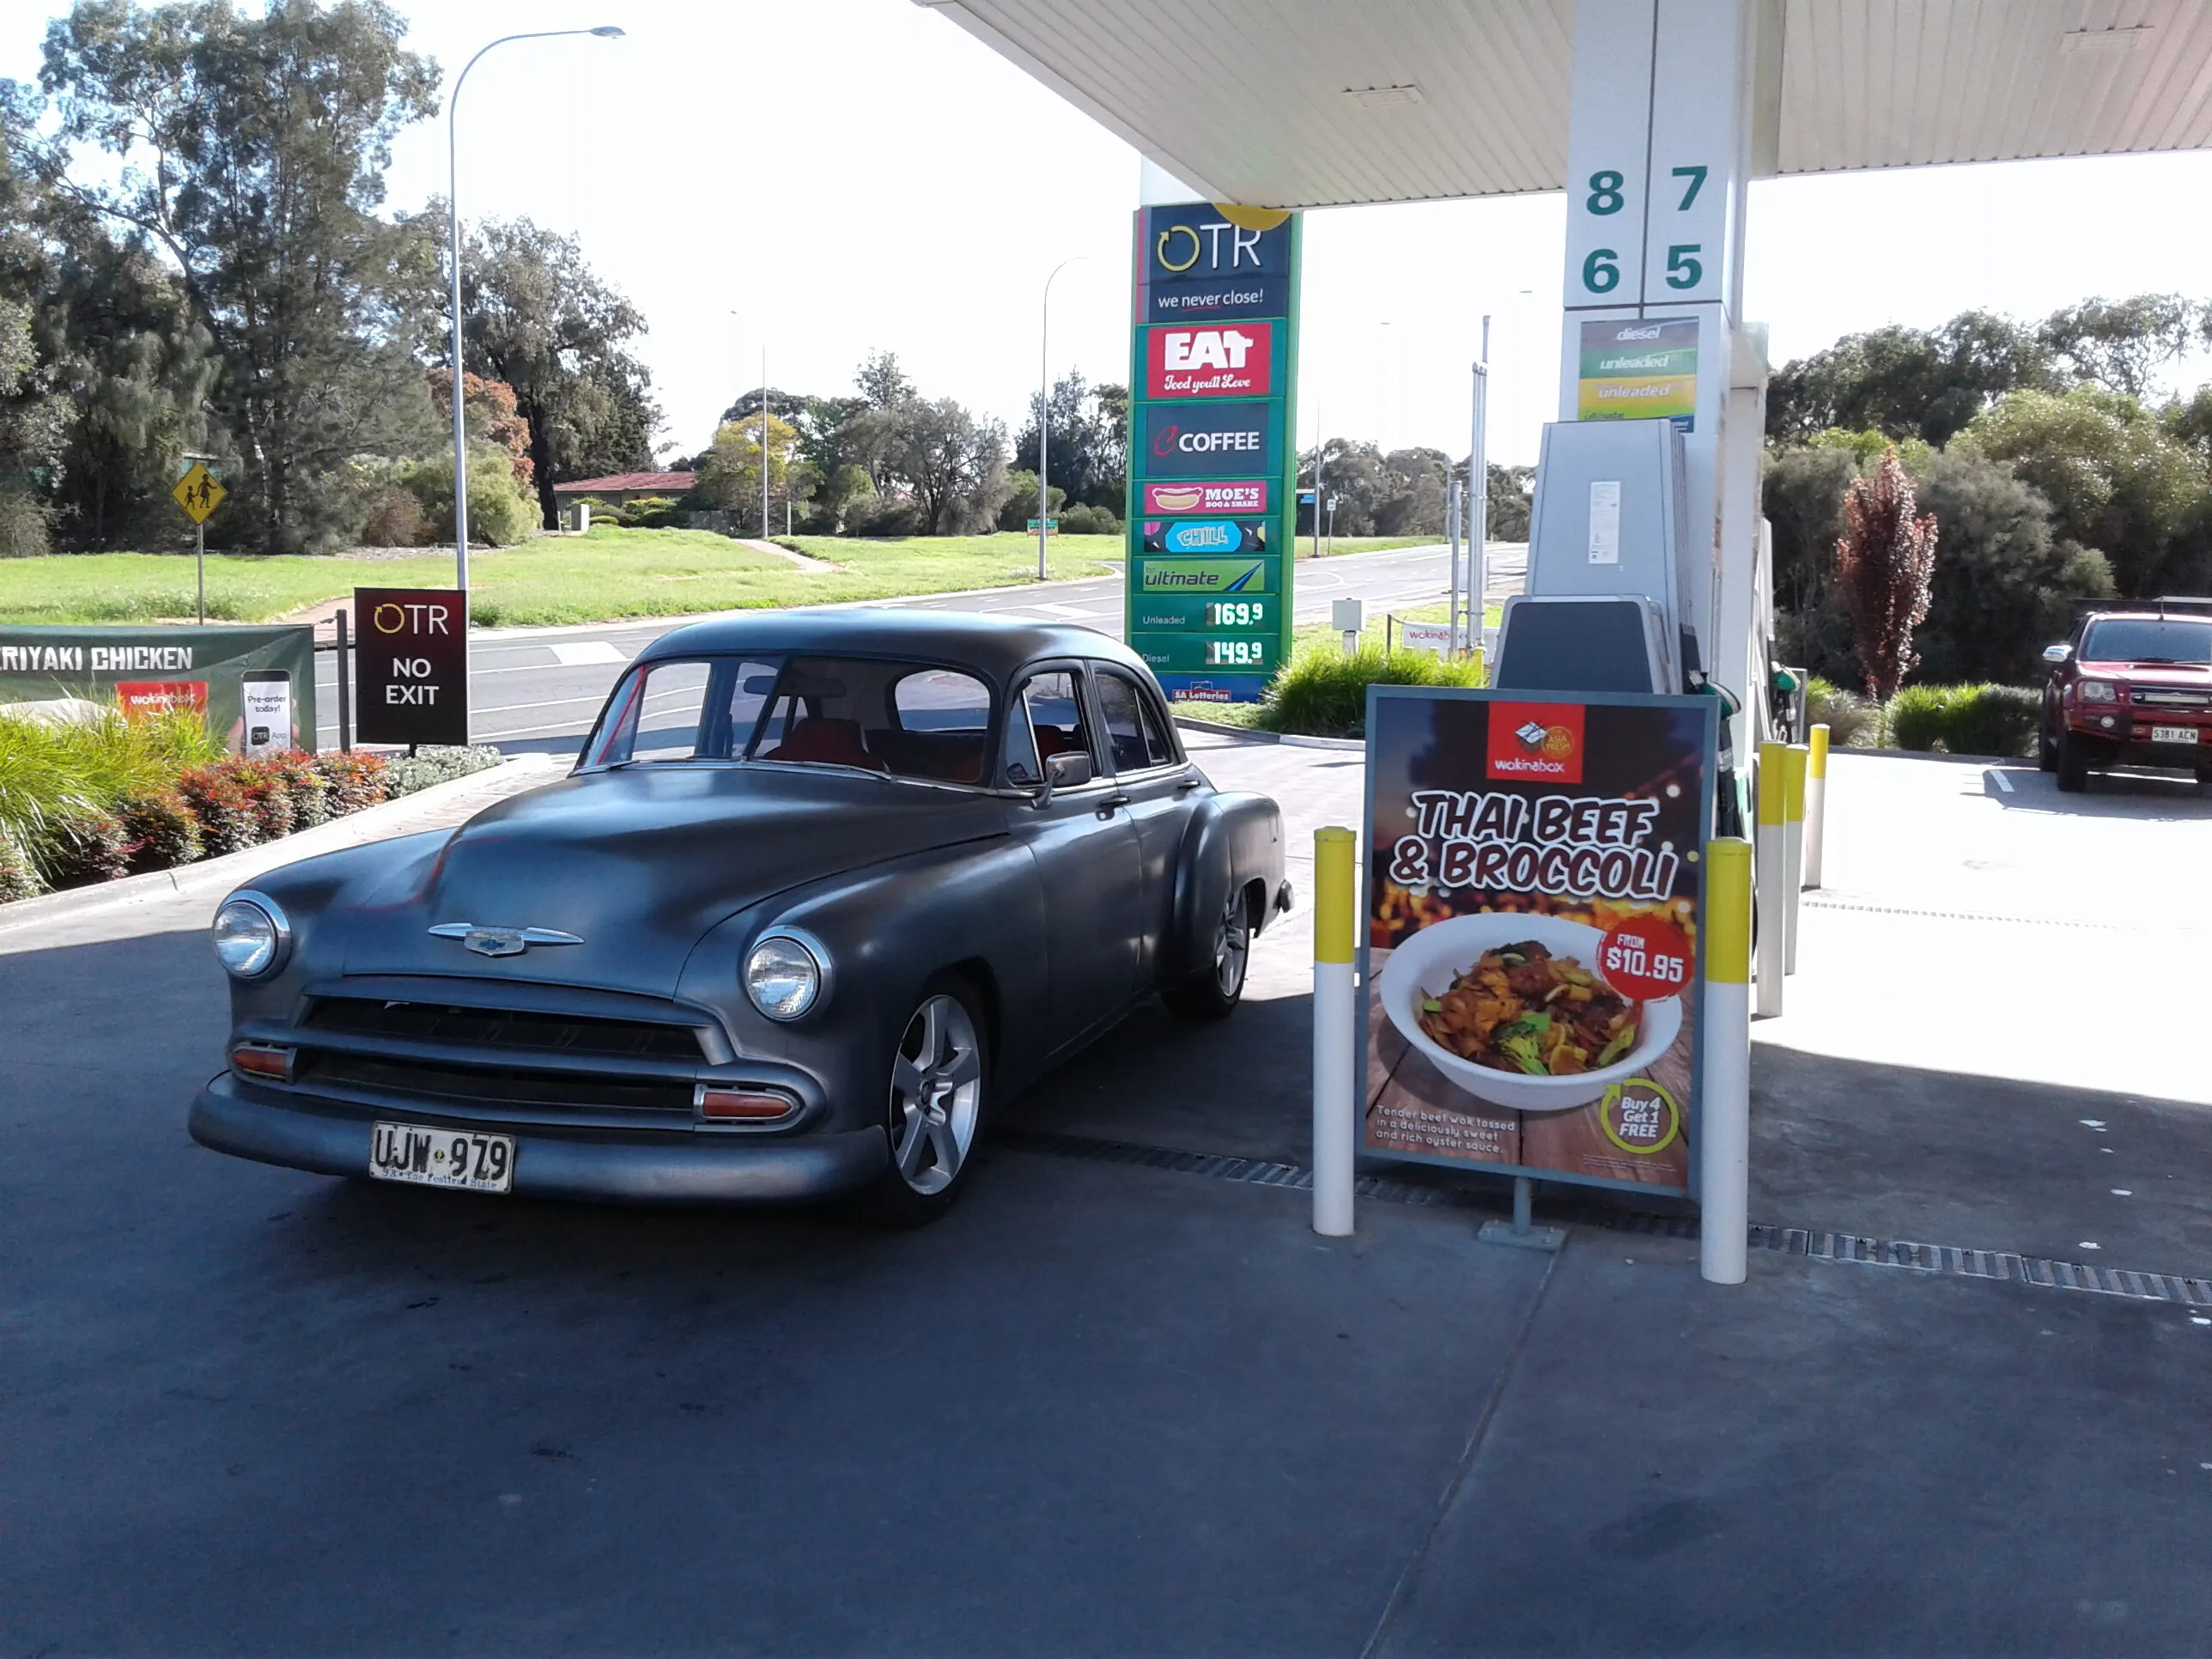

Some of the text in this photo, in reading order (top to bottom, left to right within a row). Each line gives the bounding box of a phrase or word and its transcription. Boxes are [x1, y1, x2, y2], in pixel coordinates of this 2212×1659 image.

[1586, 170, 1624, 216] 8
[1672, 166, 1708, 211] 7
[1158, 222, 1261, 271] OTR
[1582, 248, 1620, 294] 6
[1666, 244, 1703, 289] 5
[1158, 289, 1263, 307] we never close!
[1616, 325, 1661, 341] diesel
[1164, 330, 1254, 370] EAT
[1600, 355, 1669, 370] unleaded
[1164, 374, 1192, 390] Food
[1221, 374, 1251, 388] Love
[1598, 384, 1670, 398] unleaded
[1179, 431, 1260, 453] COFFEE
[1205, 488, 1260, 501] MOE'S
[1176, 526, 1229, 547] CHILL
[1145, 570, 1219, 586] ultimate
[374, 604, 448, 635] OTR
[1142, 603, 1263, 626] Unleaded 169.9
[0, 646, 192, 671] RIYAKI CHICKEN
[1142, 641, 1262, 664] Diesel 149.9
[392, 658, 431, 678] NO
[247, 695, 287, 703] Pre-order
[386, 684, 440, 705] EXIT
[1175, 690, 1229, 701] SA Lotteries
[255, 705, 281, 714] today!
[1495, 757, 1565, 773] wokinabox
[1412, 790, 1659, 848] THAI BEEF
[1389, 836, 1679, 901] & BROCCOLI
[1617, 933, 1645, 950] FROM
[1607, 946, 1684, 983] $10.95
[1621, 1096, 1661, 1112] Buy 4
[1376, 1105, 1516, 1131] Tender beef wok tossed
[1623, 1109, 1659, 1124] Get 1
[1376, 1118, 1386, 1127] in
[1400, 1120, 1460, 1138] deliciously
[1463, 1129, 1498, 1141] sweet
[1619, 1122, 1659, 1138] FREE
[1376, 1130, 1504, 1154] and rich oyster sauce.
[375, 1129, 507, 1181] UJW 979
